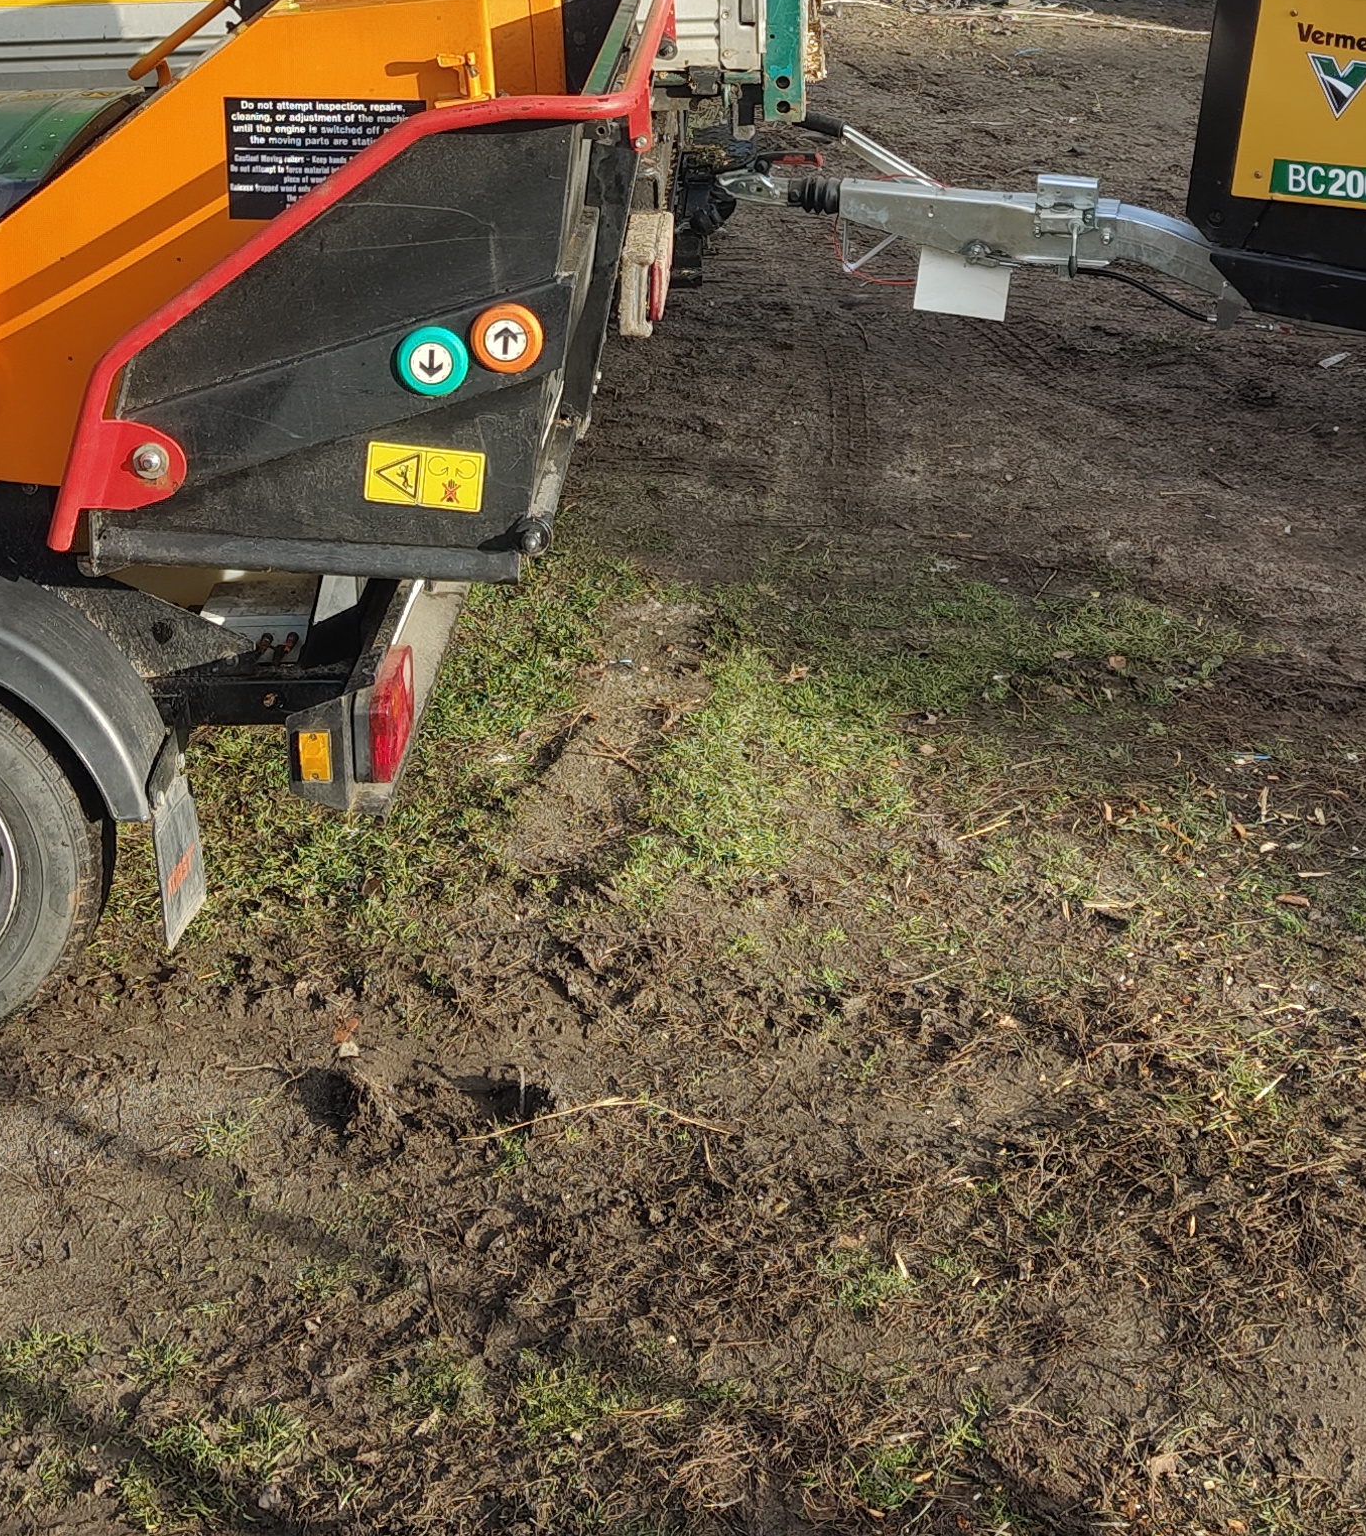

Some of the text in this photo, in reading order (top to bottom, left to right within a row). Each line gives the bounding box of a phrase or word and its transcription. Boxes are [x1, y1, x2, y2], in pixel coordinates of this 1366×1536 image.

[240, 100, 255, 110] Do
[257, 101, 273, 110] not
[276, 101, 313, 112] attempt
[316, 101, 368, 112] inspection,
[231, 111, 273, 123] cleaning,
[275, 113, 287, 122] or
[289, 112, 341, 123] adjustment
[344, 113, 355, 123] of
[358, 113, 374, 123] the
[233, 124, 253, 133] until
[256, 124, 272, 133] the
[274, 124, 306, 135] engine
[308, 125, 318, 134] is
[321, 125, 363, 134] switched
[366, 125, 380, 134] off
[249, 135, 266, 144] the
[268, 135, 302, 147] moving
[304, 136, 330, 146] parts
[333, 137, 349, 146] are
